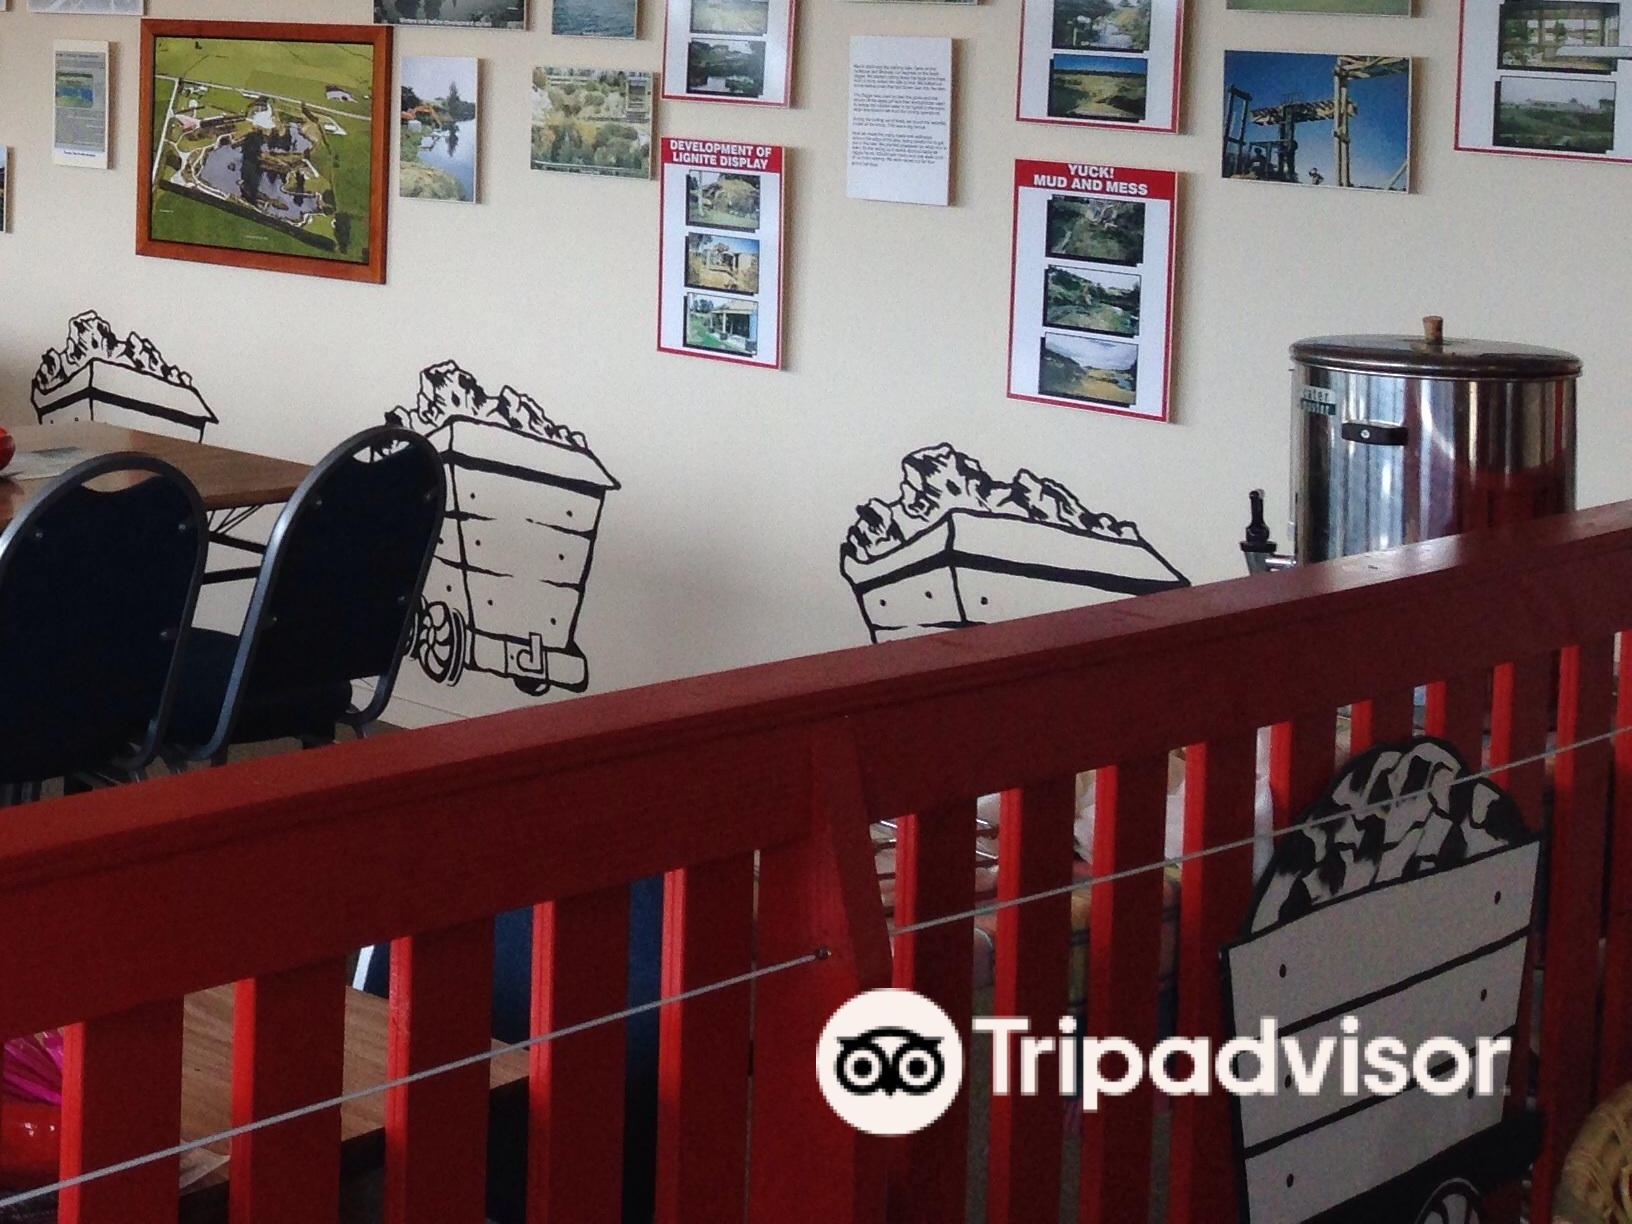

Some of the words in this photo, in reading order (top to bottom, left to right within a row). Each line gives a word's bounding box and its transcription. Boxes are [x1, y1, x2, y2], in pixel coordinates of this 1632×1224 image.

[669, 139, 754, 156] DEVELOPMENT
[755, 146, 773, 158] OF
[672, 151, 718, 166] LIGNITE
[719, 155, 769, 170] DISPLAY
[1067, 163, 1115, 179] YUCK!
[1033, 174, 1068, 188] MUD
[1071, 178, 1103, 191] AND
[1105, 182, 1149, 196] MESS
